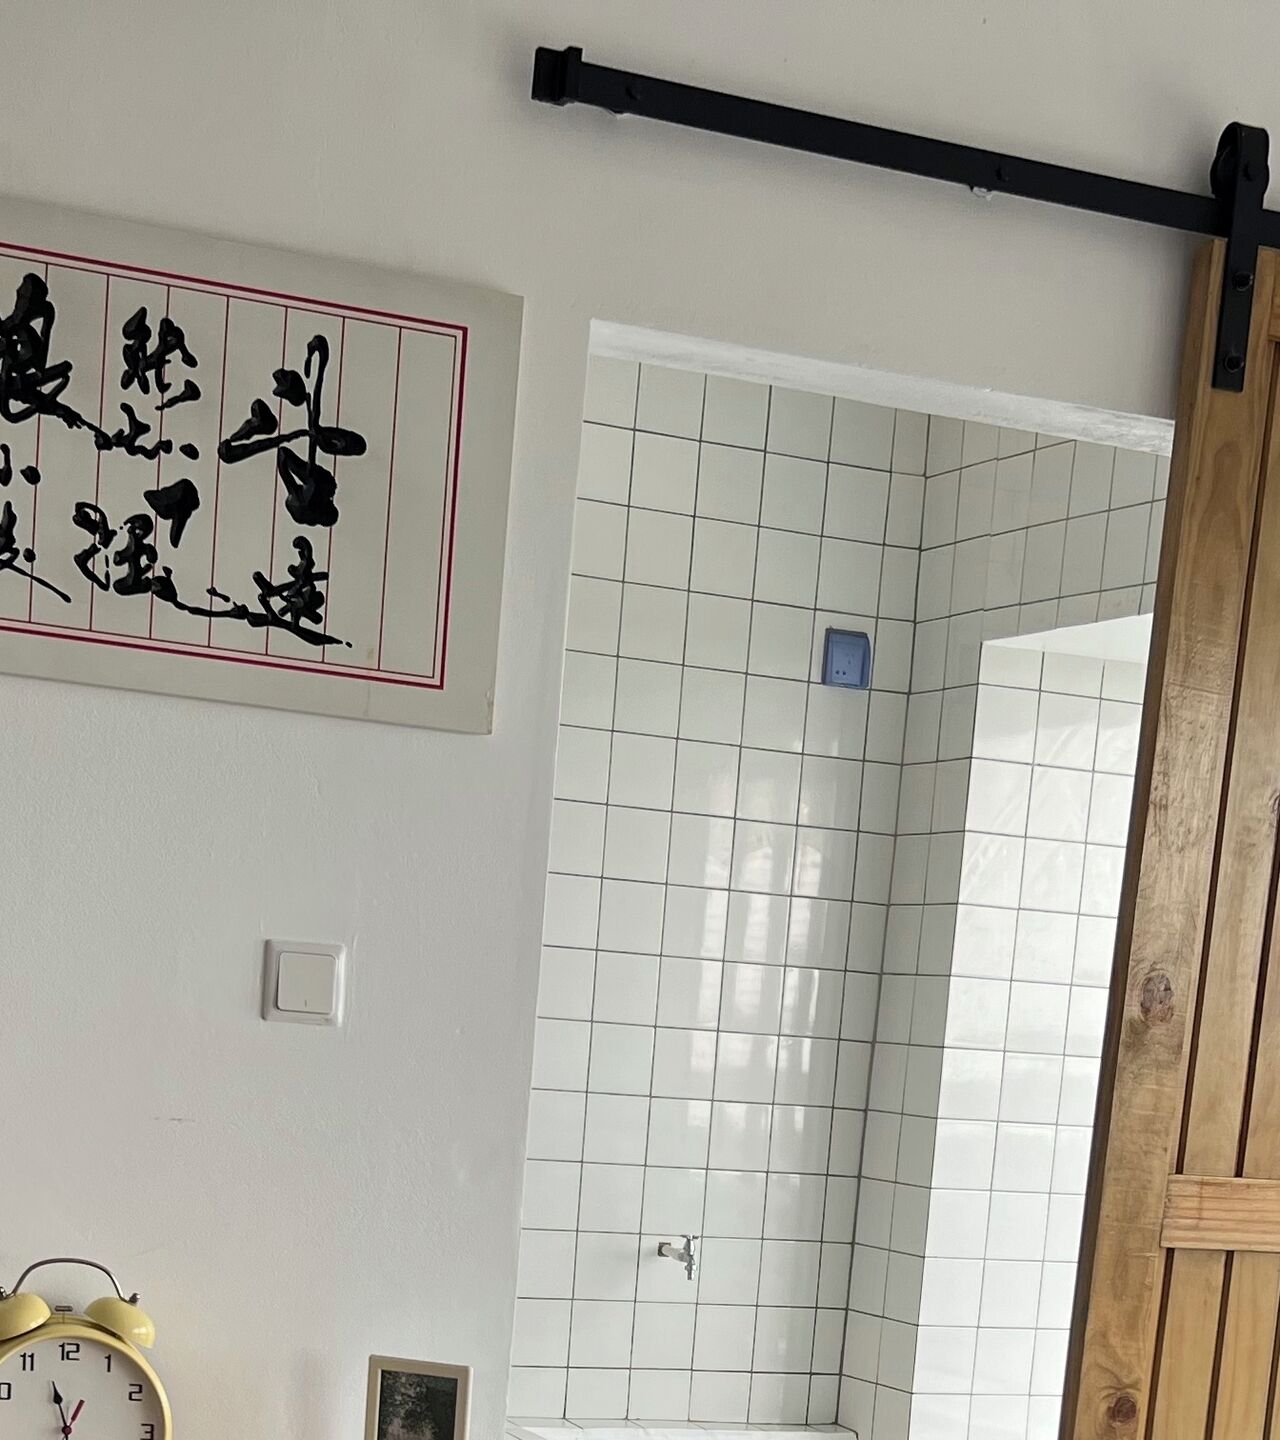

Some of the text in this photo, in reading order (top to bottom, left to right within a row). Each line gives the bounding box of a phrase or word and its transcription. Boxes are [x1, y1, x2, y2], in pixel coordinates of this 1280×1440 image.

[59, 1342, 80, 1361] 12
[20, 1353, 35, 1371] 11
[104, 1354, 112, 1373] 1
[128, 1384, 143, 1401] 2
[140, 1423, 154, 1440] 3
